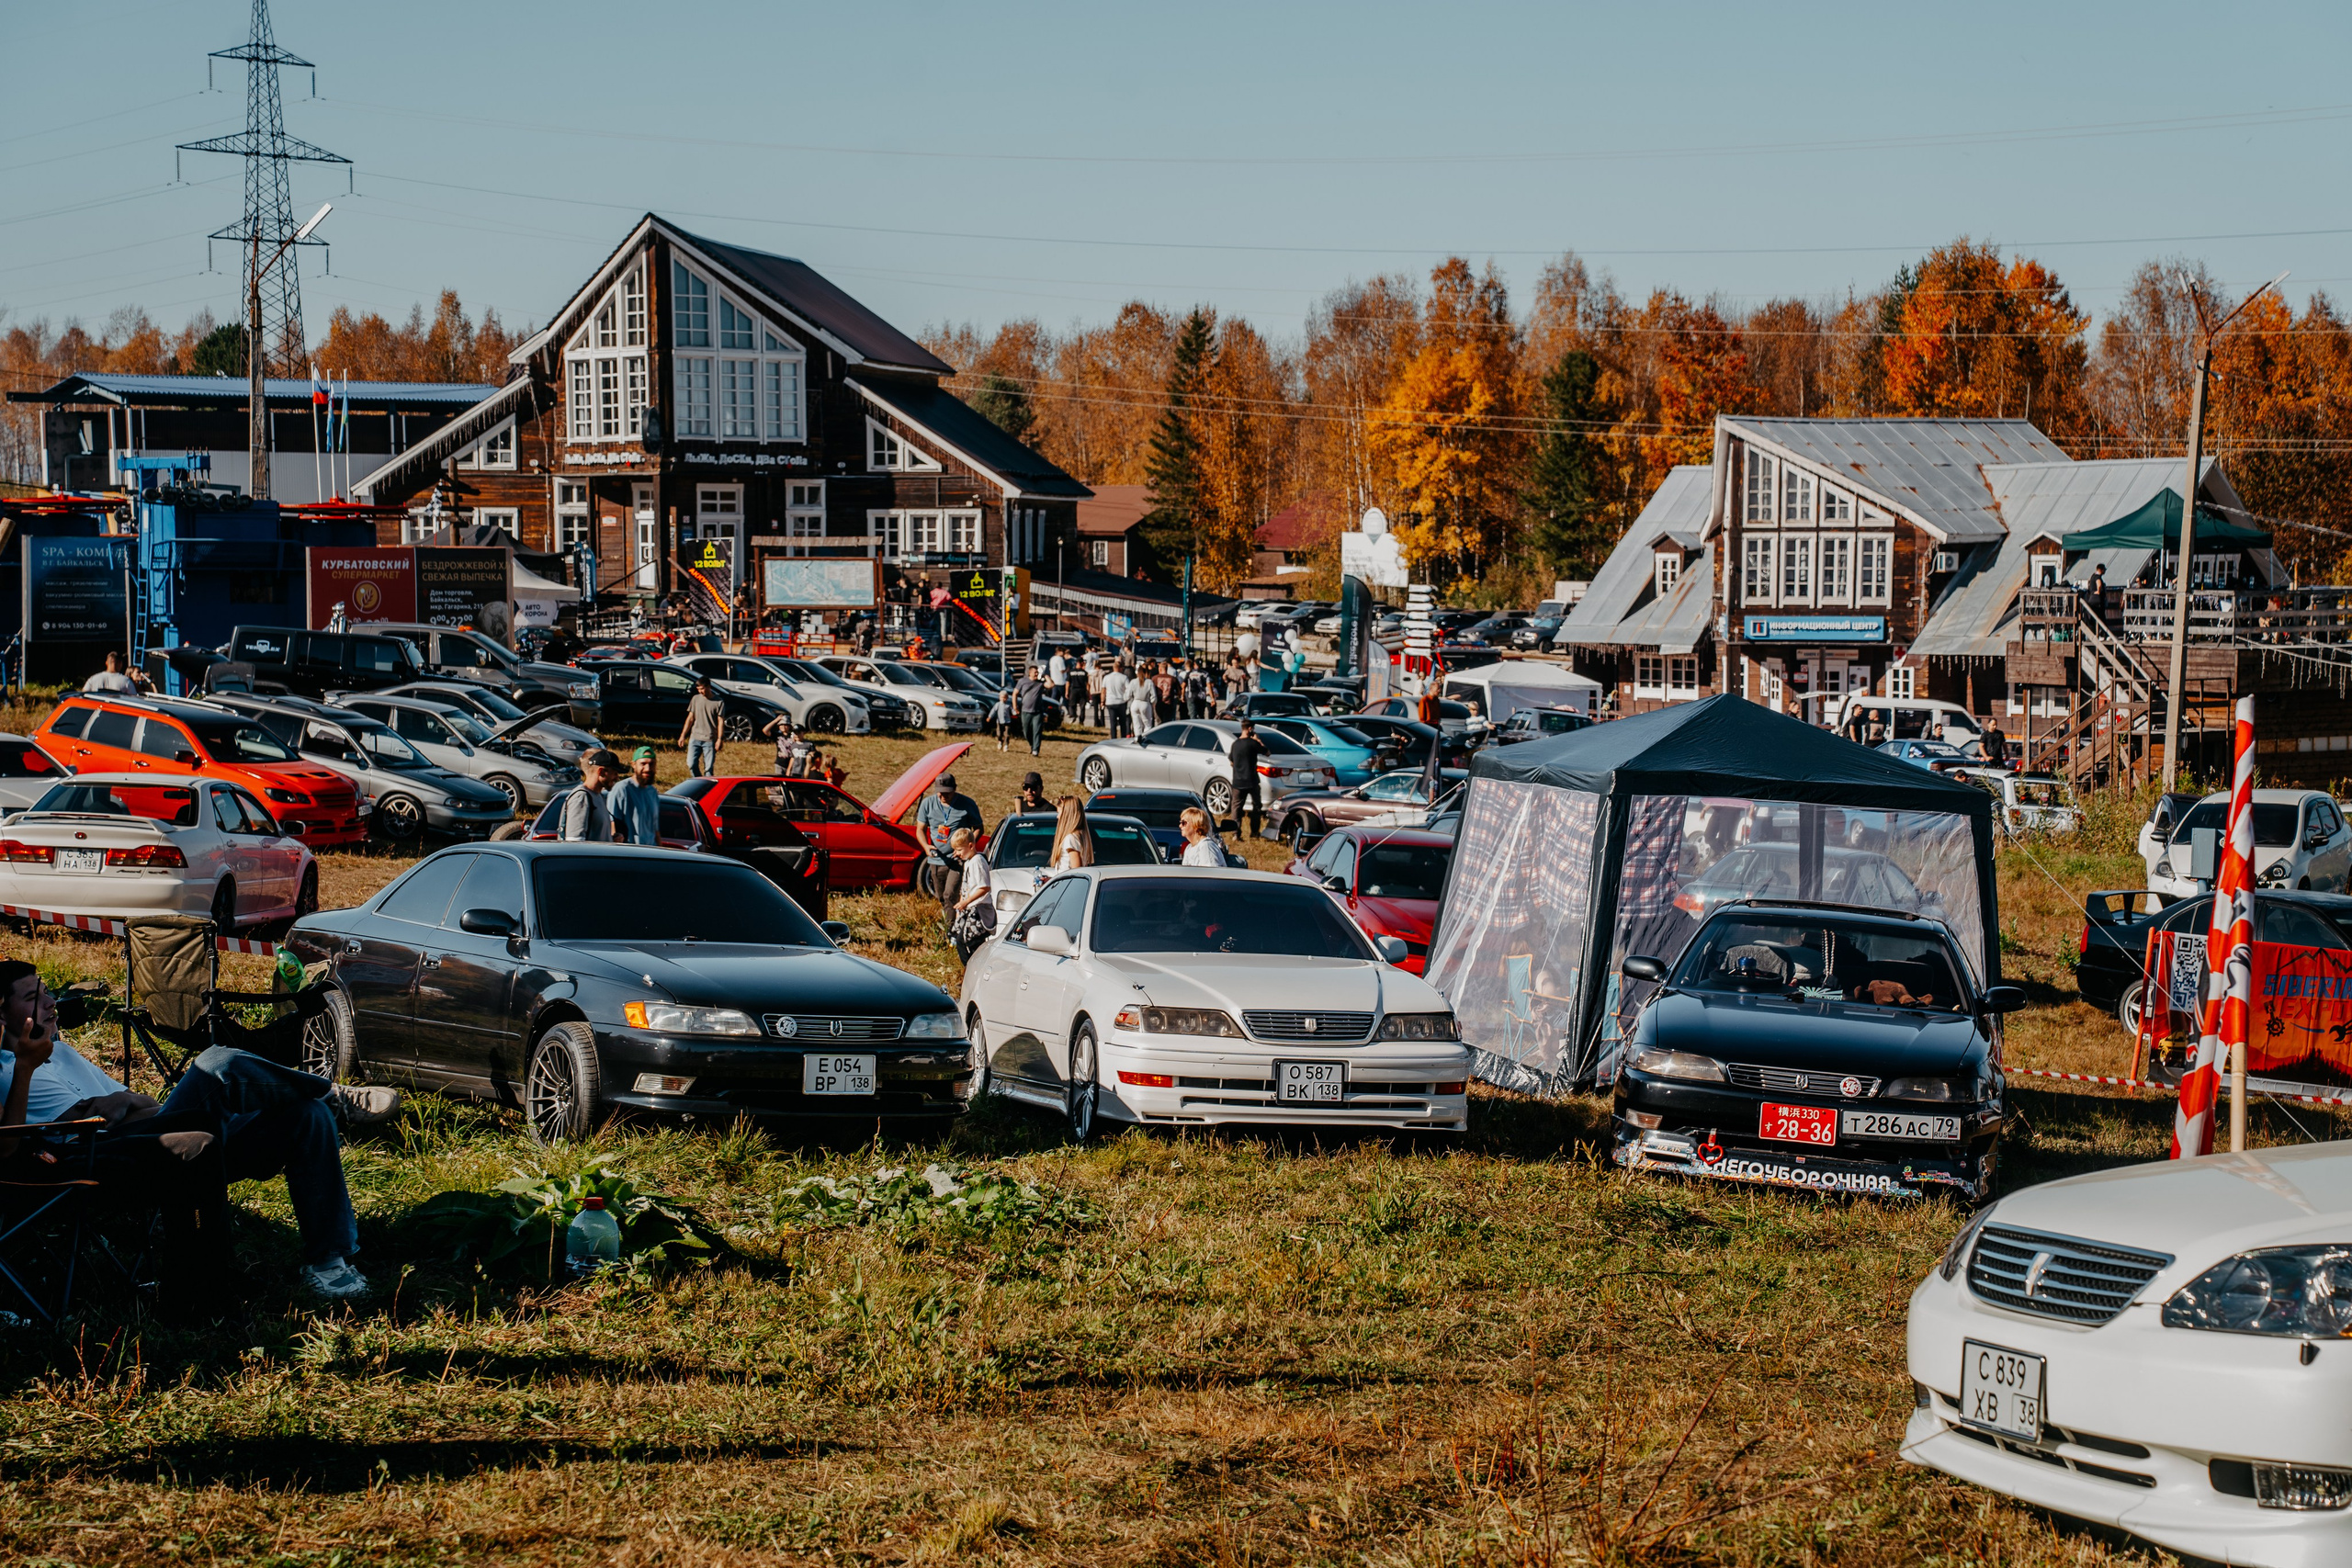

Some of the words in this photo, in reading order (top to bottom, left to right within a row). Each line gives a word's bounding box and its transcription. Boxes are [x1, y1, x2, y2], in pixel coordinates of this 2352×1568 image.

[42, 547, 64, 557] SPA
[57, 558, 104, 567] БАЙКАЛЬСК
[322, 558, 410, 570] КУРБАТОВСКИЙ
[422, 559, 497, 571] БЕЗДРОЖЖЕВОЙ
[332, 571, 400, 580] СУПЕРМАРКЕТ
[422, 573, 459, 581] СВЕЖАЯ
[461, 573, 503, 581] ВЫПЕЧКА
[688, 568, 731, 615] АККУМУЛЯТОРЫ
[959, 590, 968, 598] 12
[969, 589, 996, 597] ВОЛЬТ
[1770, 621, 1850, 630] ИНФОРМАЦИОННЫЙ
[1851, 622, 1879, 630] ЦЕНТР
[2279, 997, 2349, 1022] EXPO
[819, 1058, 829, 1073] Е
[834, 1058, 861, 1073] 054
[1289, 1066, 1301, 1079] О
[1306, 1066, 1333, 1080] 587
[815, 1077, 837, 1091] ВР
[851, 1077, 870, 1088] 138
[1287, 1084, 1308, 1099] ВК
[1317, 1085, 1339, 1096] 138
[1778, 1106, 1820, 1120] 横浜330
[1777, 1118, 1832, 1143] 28-36
[1936, 1118, 1954, 1133] 79
[1979, 1351, 1991, 1381] С
[1996, 1355, 2027, 1390] 839
[1974, 1388, 1998, 1422] ХВ
[2019, 1400, 2035, 1426] 38
